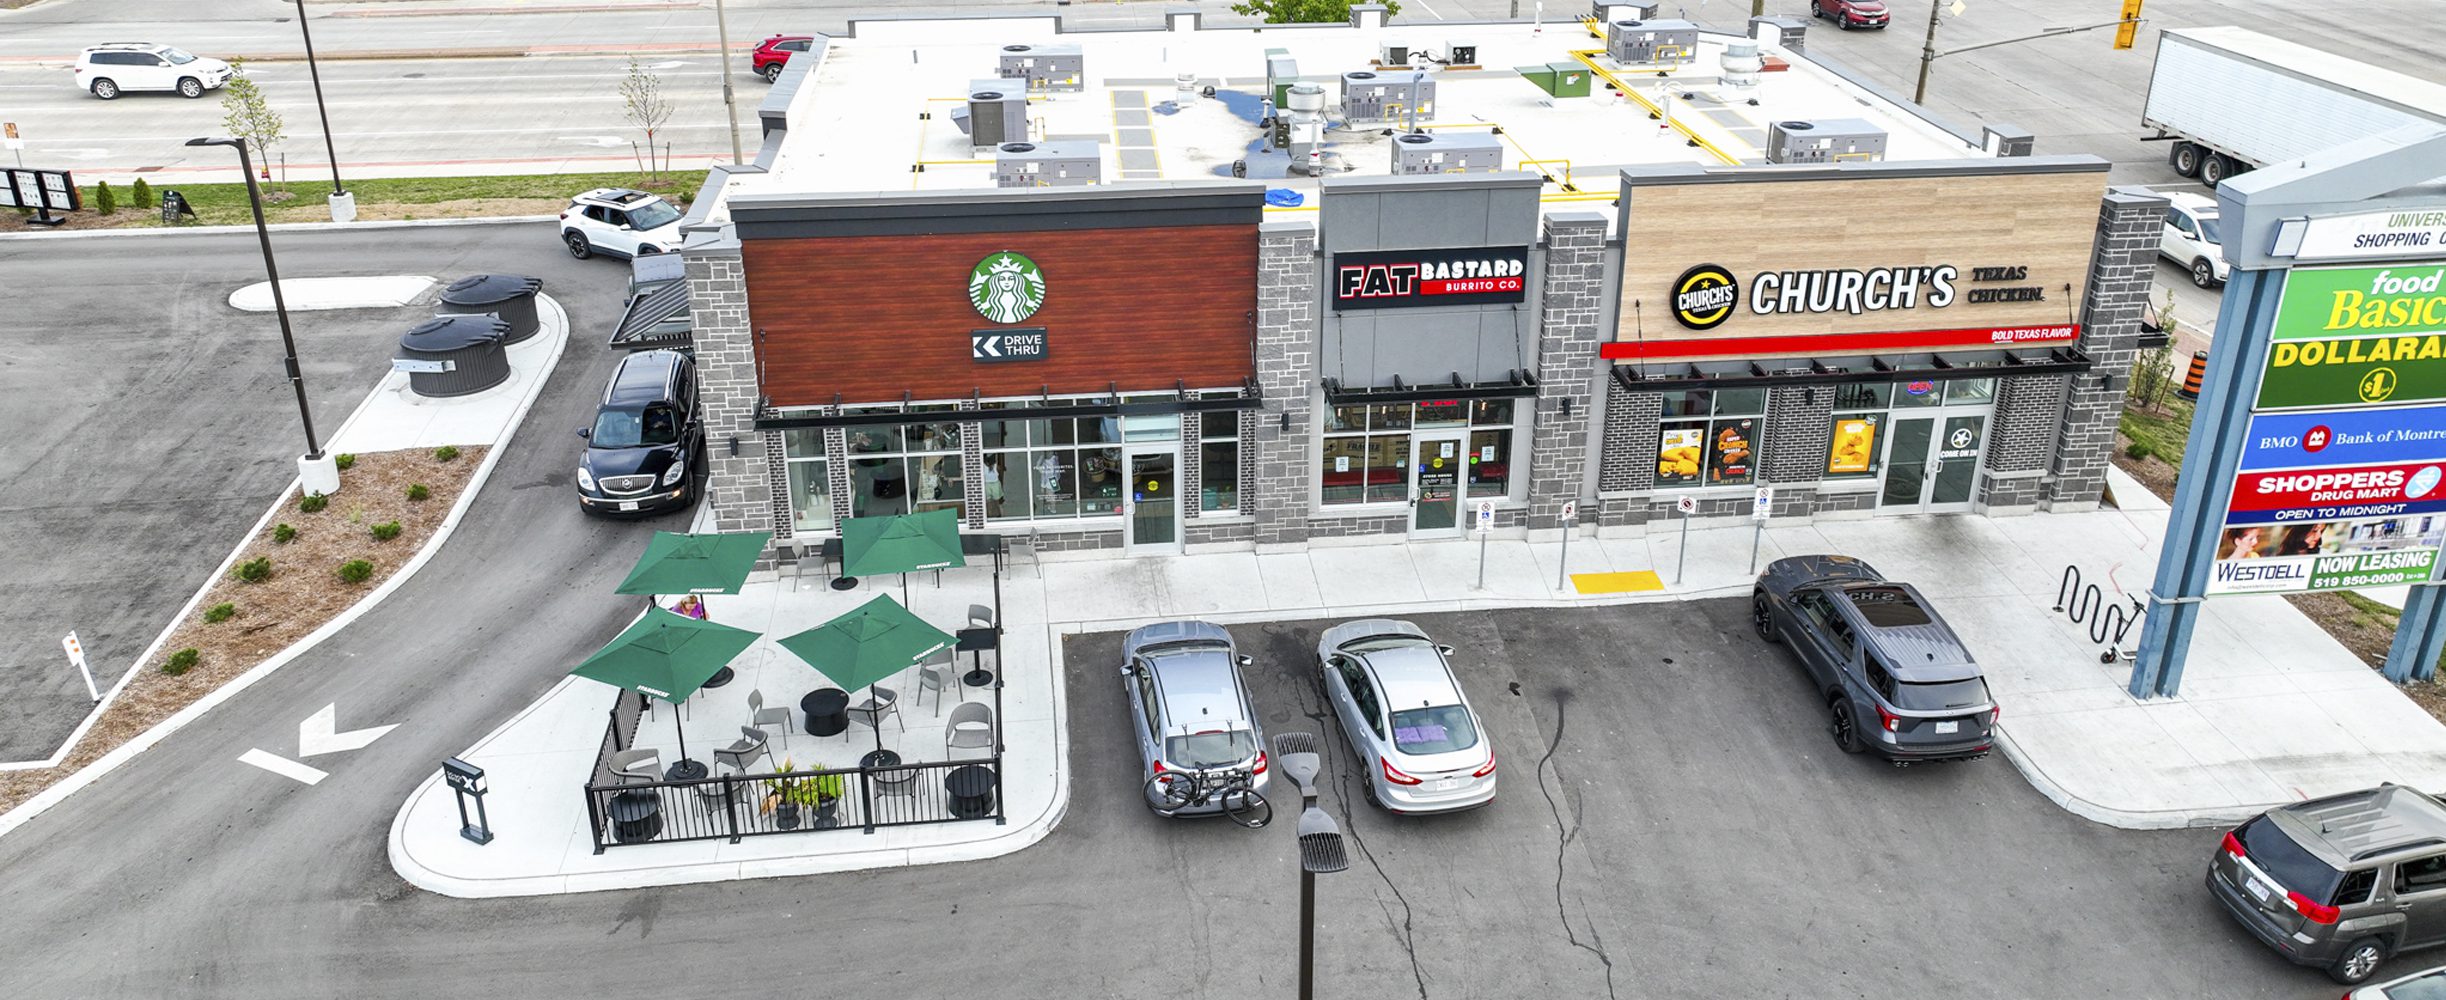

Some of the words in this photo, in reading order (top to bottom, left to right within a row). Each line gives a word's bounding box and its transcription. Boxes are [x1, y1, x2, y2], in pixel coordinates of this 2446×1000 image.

[2354, 231, 2431, 248] SHOPPING
[1340, 262, 1419, 298] FAT
[1420, 259, 1524, 280] BASTARD
[1972, 266, 2028, 282] TEXAS
[2371, 269, 2445, 294] food
[1446, 281, 1494, 292] BURRITO
[1499, 280, 1521, 290] CO.
[1750, 264, 1958, 315] CHURCH'S
[1678, 284, 1734, 310] CHURCH'S
[2323, 290, 2446, 330] Basic
[1004, 335, 1042, 346] DRIVE
[1991, 330, 2013, 341] BOLD
[2014, 329, 2040, 340] TEXAS
[2041, 327, 2072, 338] FLAVOR
[1005, 345, 1040, 356] THRU
[2273, 335, 2446, 367] DOLLARA
[2259, 435, 2298, 449] BMO
[2336, 431, 2374, 445] Bank
[2376, 429, 2394, 443] of
[1940, 450, 1959, 458] COME
[2256, 470, 2405, 494] SHOPPERS
[2310, 489, 2354, 502] DRUG
[2356, 487, 2401, 499] MART
[2275, 509, 2313, 520] OPEN
[2317, 507, 2336, 518] TO
[2339, 503, 2407, 516] MIDNIGHT
[2317, 556, 2359, 574] NOW
[2358, 551, 2432, 571] LEASING
[2314, 577, 2339, 588] 519
[2342, 572, 2404, 586] 850-0000
